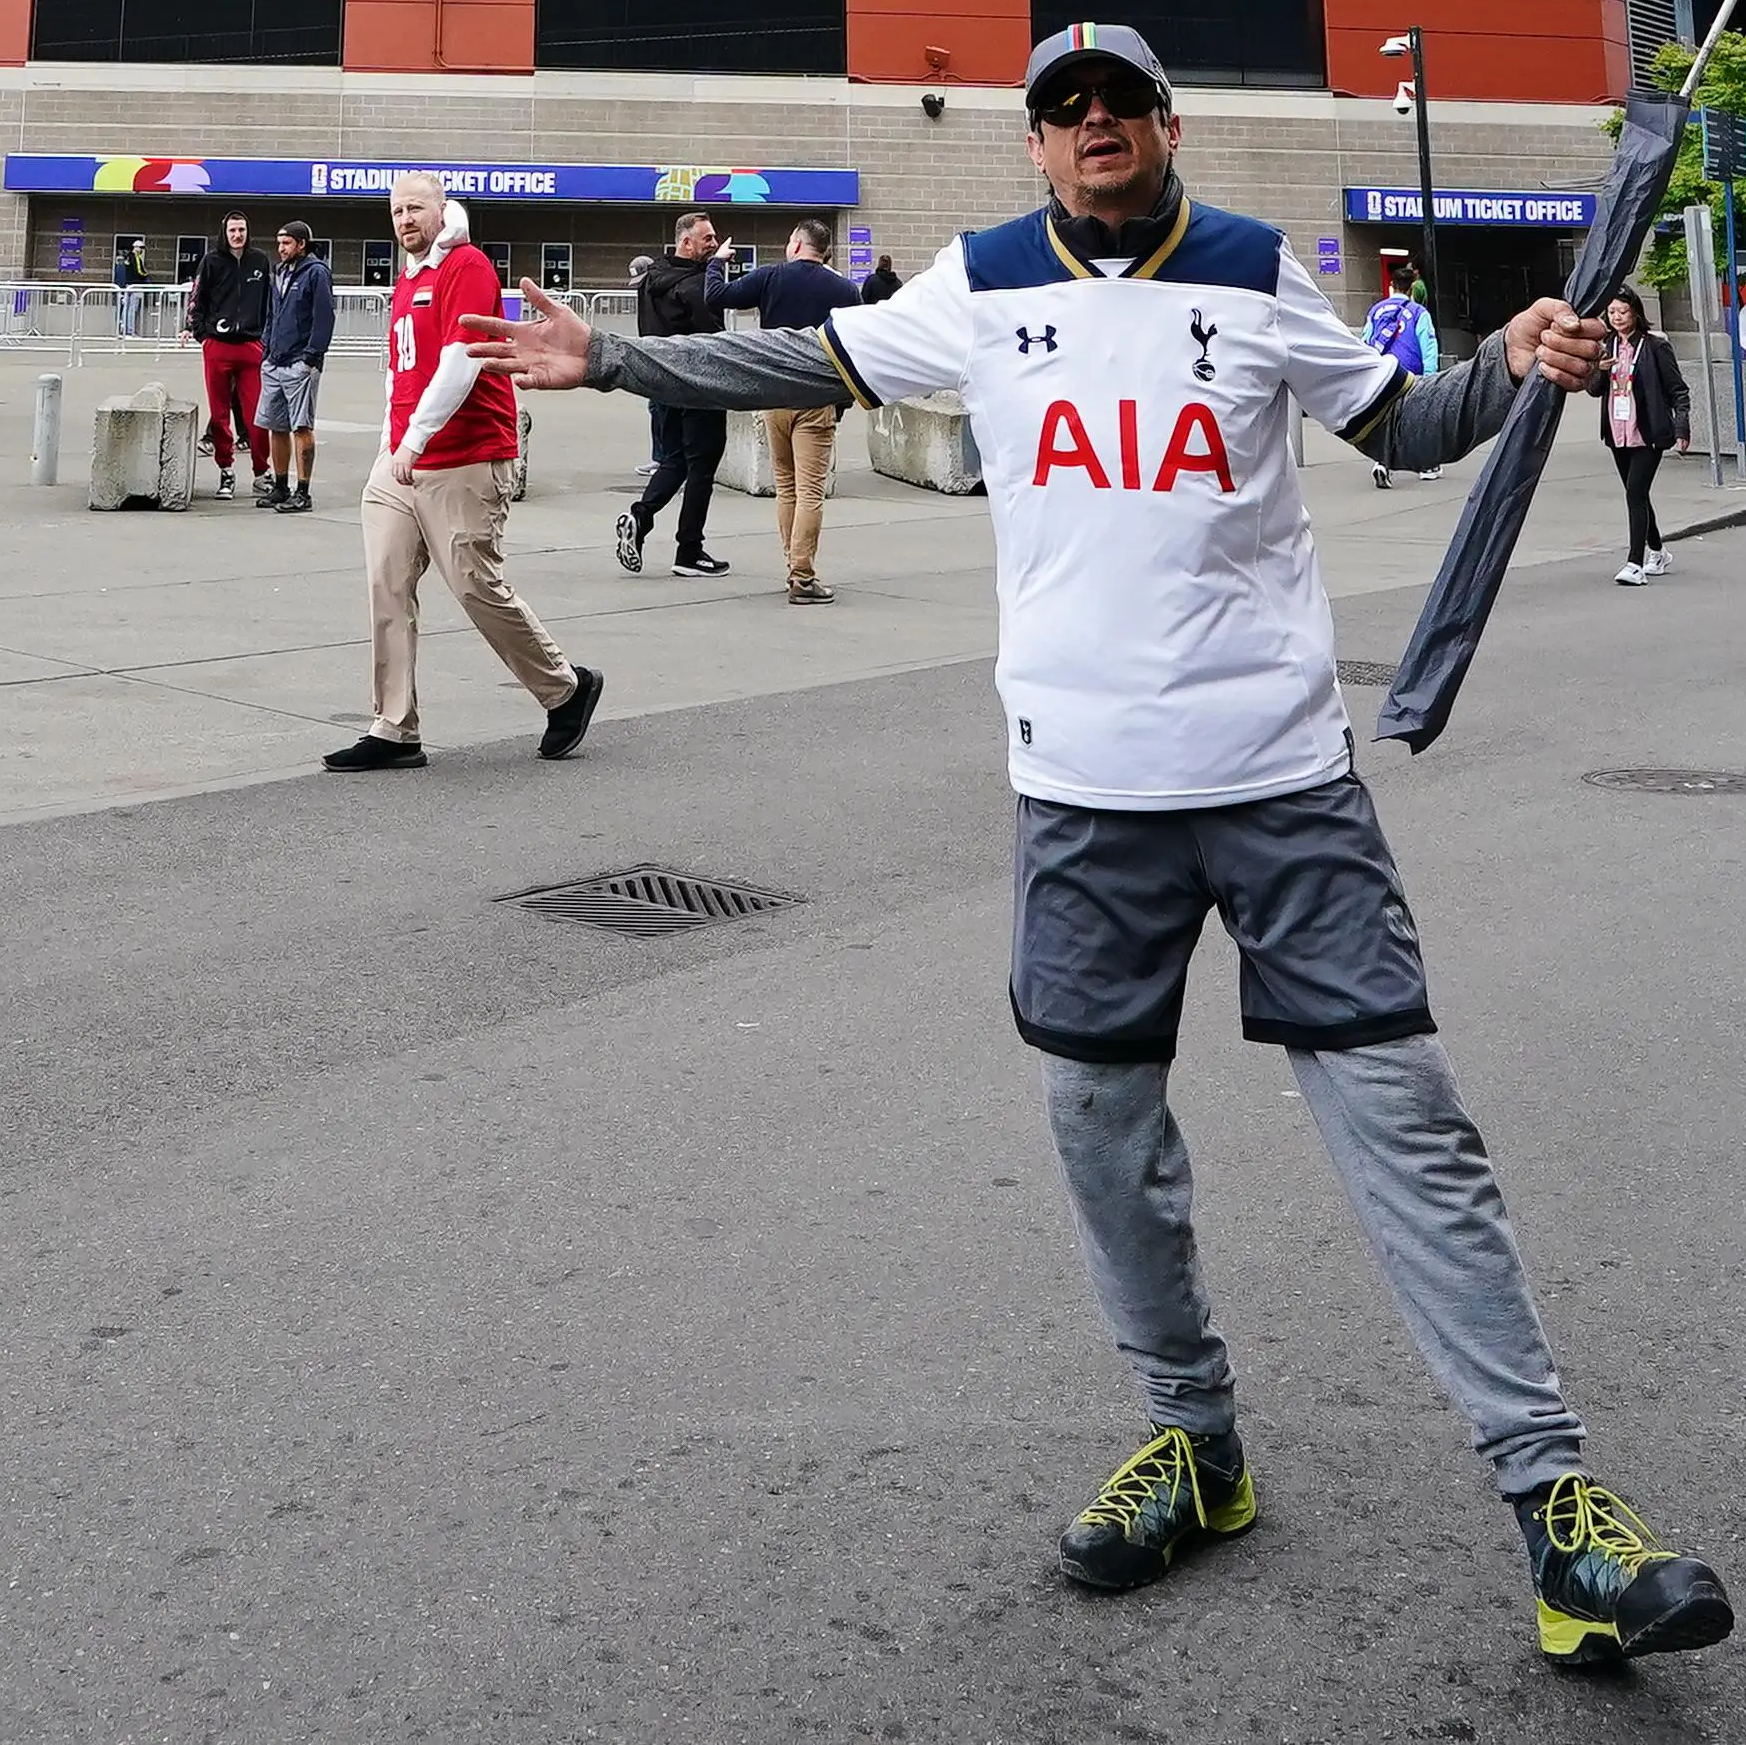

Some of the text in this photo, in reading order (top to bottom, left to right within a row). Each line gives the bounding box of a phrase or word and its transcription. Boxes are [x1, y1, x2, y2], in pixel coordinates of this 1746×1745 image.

[489, 171, 556, 193] OFFICE
[1465, 198, 1523, 221] TICKET
[1525, 199, 1583, 221] OFFICE
[394, 314, 416, 372] 10
[1033, 399, 1235, 492] AIA
